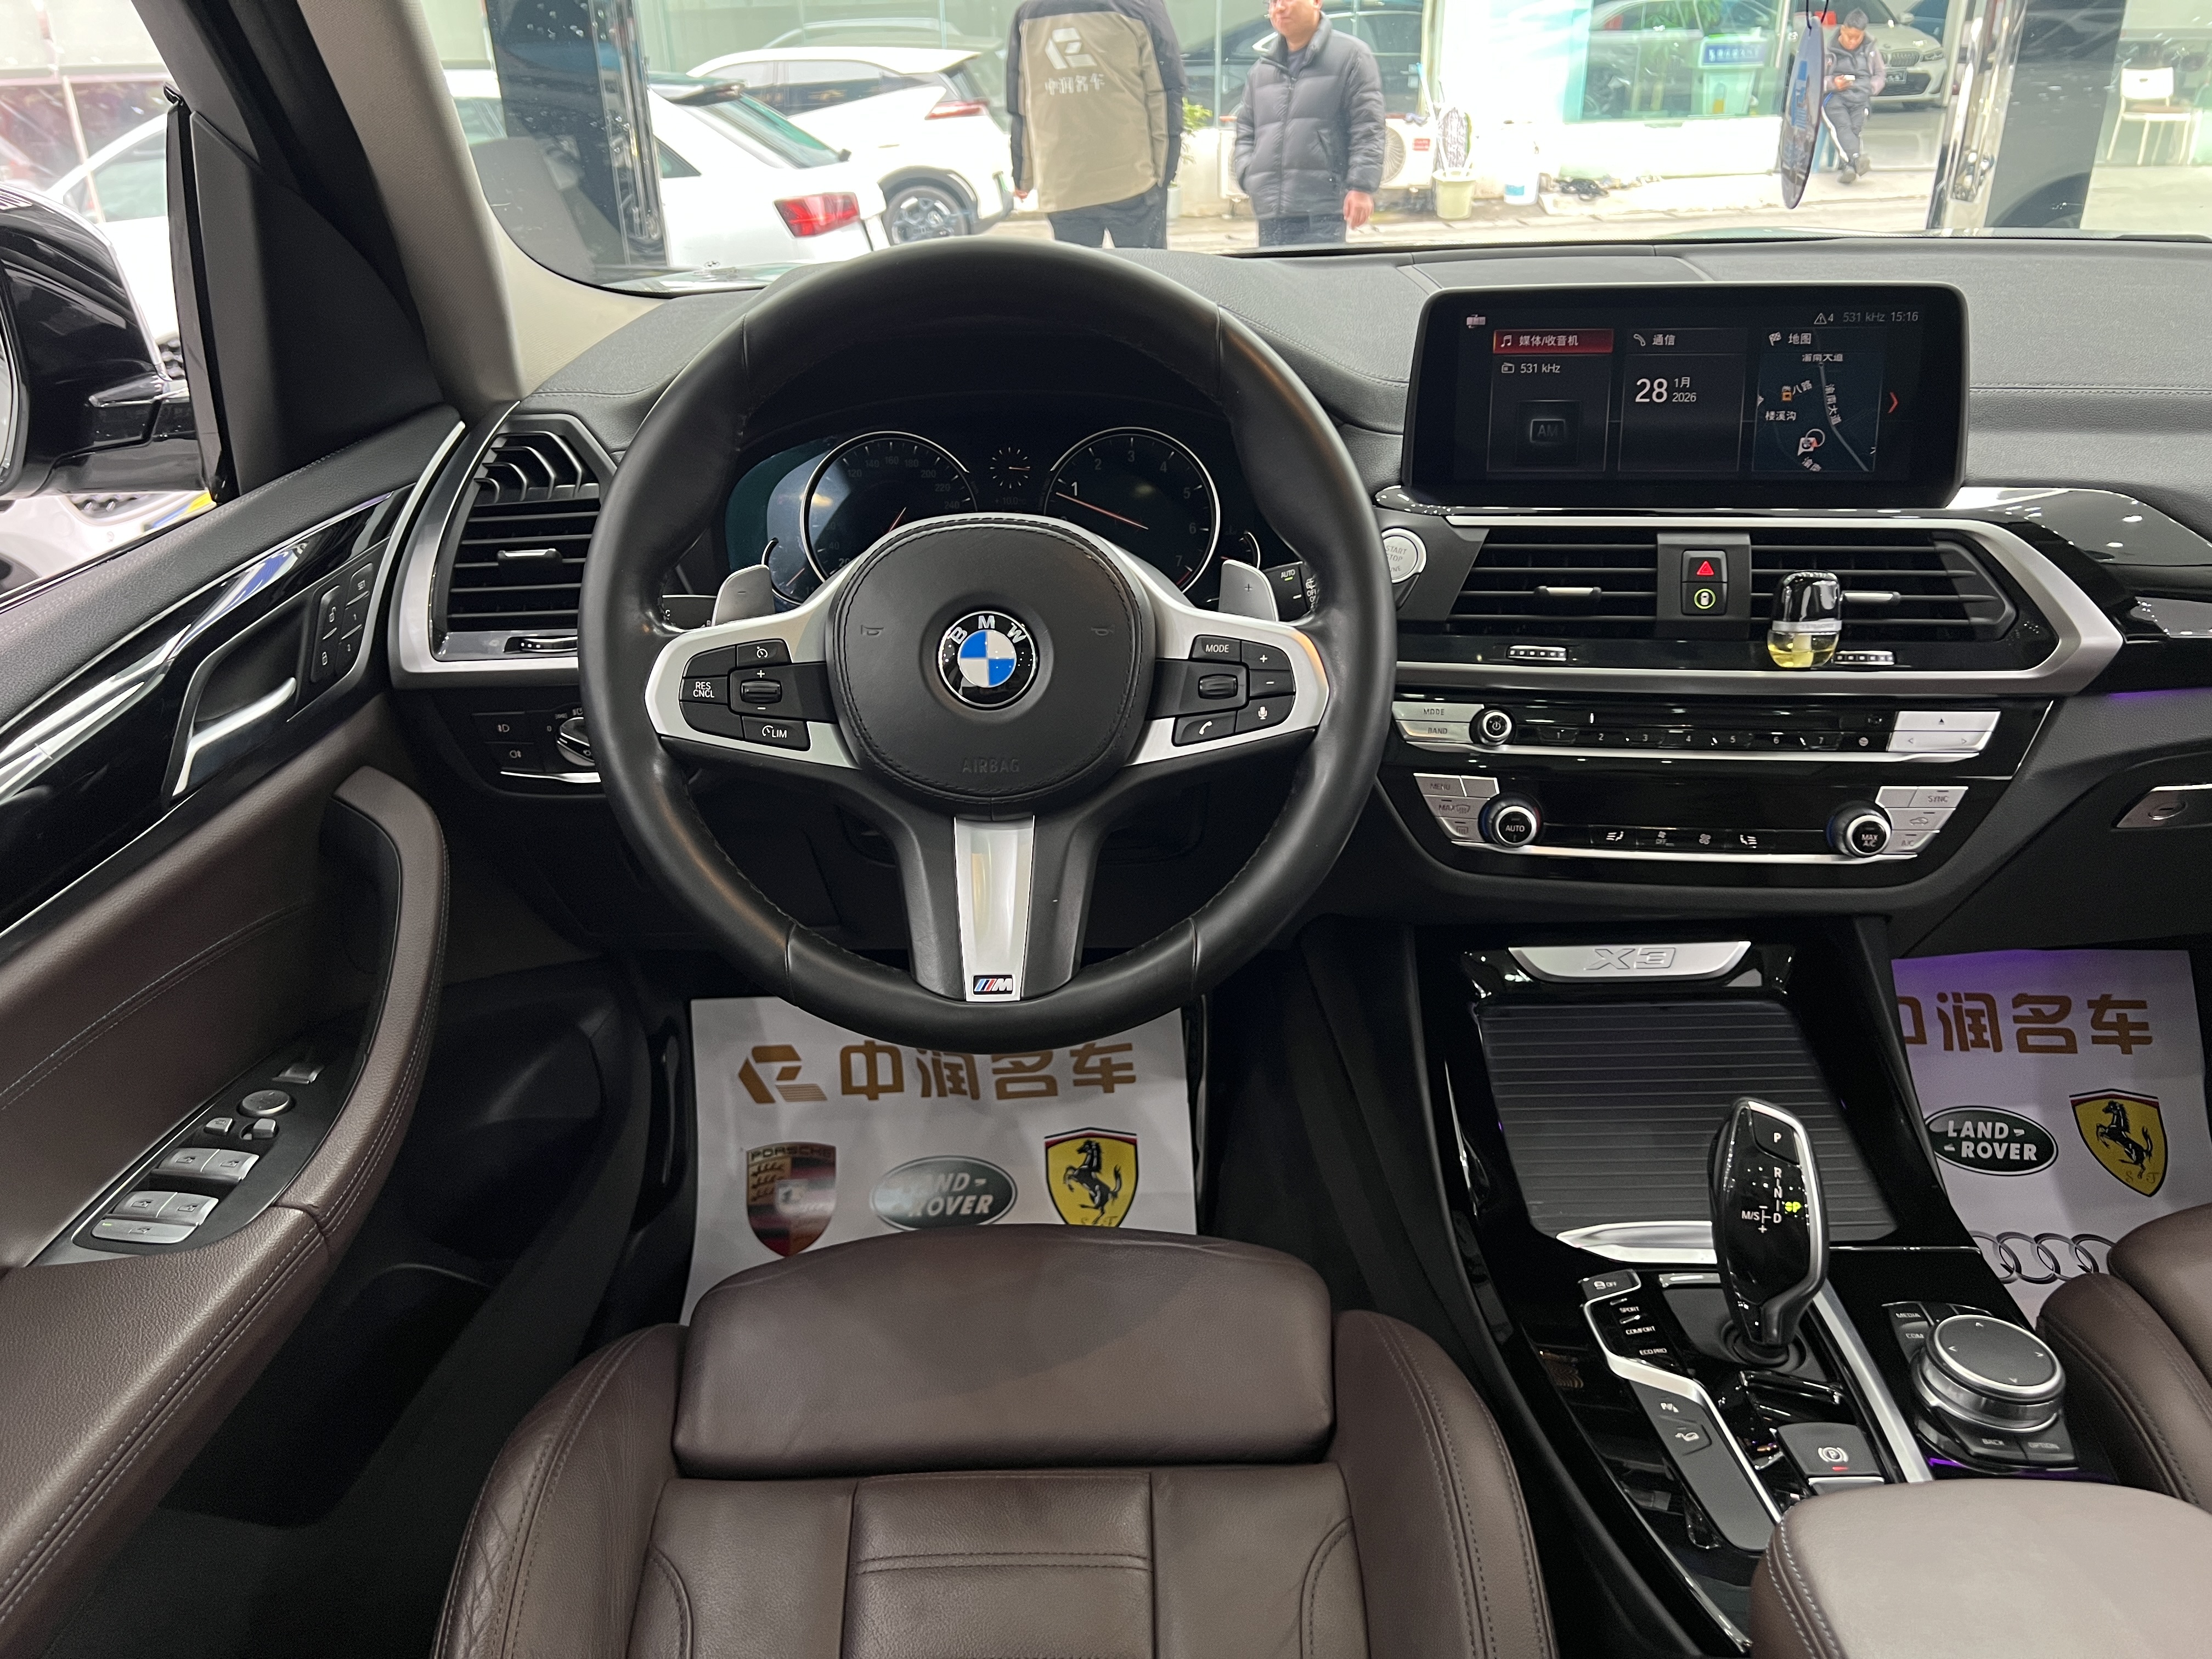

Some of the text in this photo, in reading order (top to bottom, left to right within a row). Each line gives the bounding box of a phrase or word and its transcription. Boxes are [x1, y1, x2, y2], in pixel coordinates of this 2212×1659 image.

[1828, 314, 1833, 322] 4
[1843, 312, 1885, 322] 531 kHz
[1891, 312, 1918, 321] 15:16
[1519, 335, 1578, 347] 媒体/收音机
[1652, 334, 1675, 346] 通信
[1788, 332, 1812, 345] 地图
[1520, 363, 1560, 374] 531 kHz
[1674, 376, 1690, 388] 1月
[1635, 378, 1668, 403] 28
[1672, 392, 1696, 402] 2026
[1538, 425, 1558, 437] AM
[884, 456, 899, 465] 160
[1128, 450, 1135, 462] 3
[905, 459, 919, 467] 180
[1094, 458, 1102, 470] 2
[1160, 461, 1167, 472] 4
[848, 469, 862, 477] 120
[921, 470, 936, 478] 200
[935, 483, 951, 492] 220
[1071, 481, 1077, 496] 1
[1183, 487, 1190, 499] 5
[944, 501, 960, 509] 240
[1189, 522, 1197, 534] 6
[829, 541, 839, 550] 40
[1386, 545, 1407, 555] START
[839, 558, 850, 567] 20
[1175, 555, 1183, 566] 7
[1281, 569, 1295, 578] AUTO
[950, 615, 1027, 645] BMW
[1205, 644, 1229, 653] MODE
[695, 681, 711, 690] RES
[693, 689, 715, 698] CNCL
[771, 729, 787, 738] LIM
[962, 758, 1019, 773] AIRBAG
[1584, 947, 1677, 970] X3
[839, 1040, 1136, 1101] 中润名车
[1948, 1120, 2009, 1139] LAND
[1774, 1132, 1782, 1143] P
[1961, 1141, 2037, 1161] ROVER
[1774, 1166, 1782, 1178] R
[1774, 1187, 1782, 1198] N
[1741, 1210, 1760, 1221] M/S
[1773, 1213, 1782, 1223] D
[1626, 1325, 1656, 1335] COMFORT
